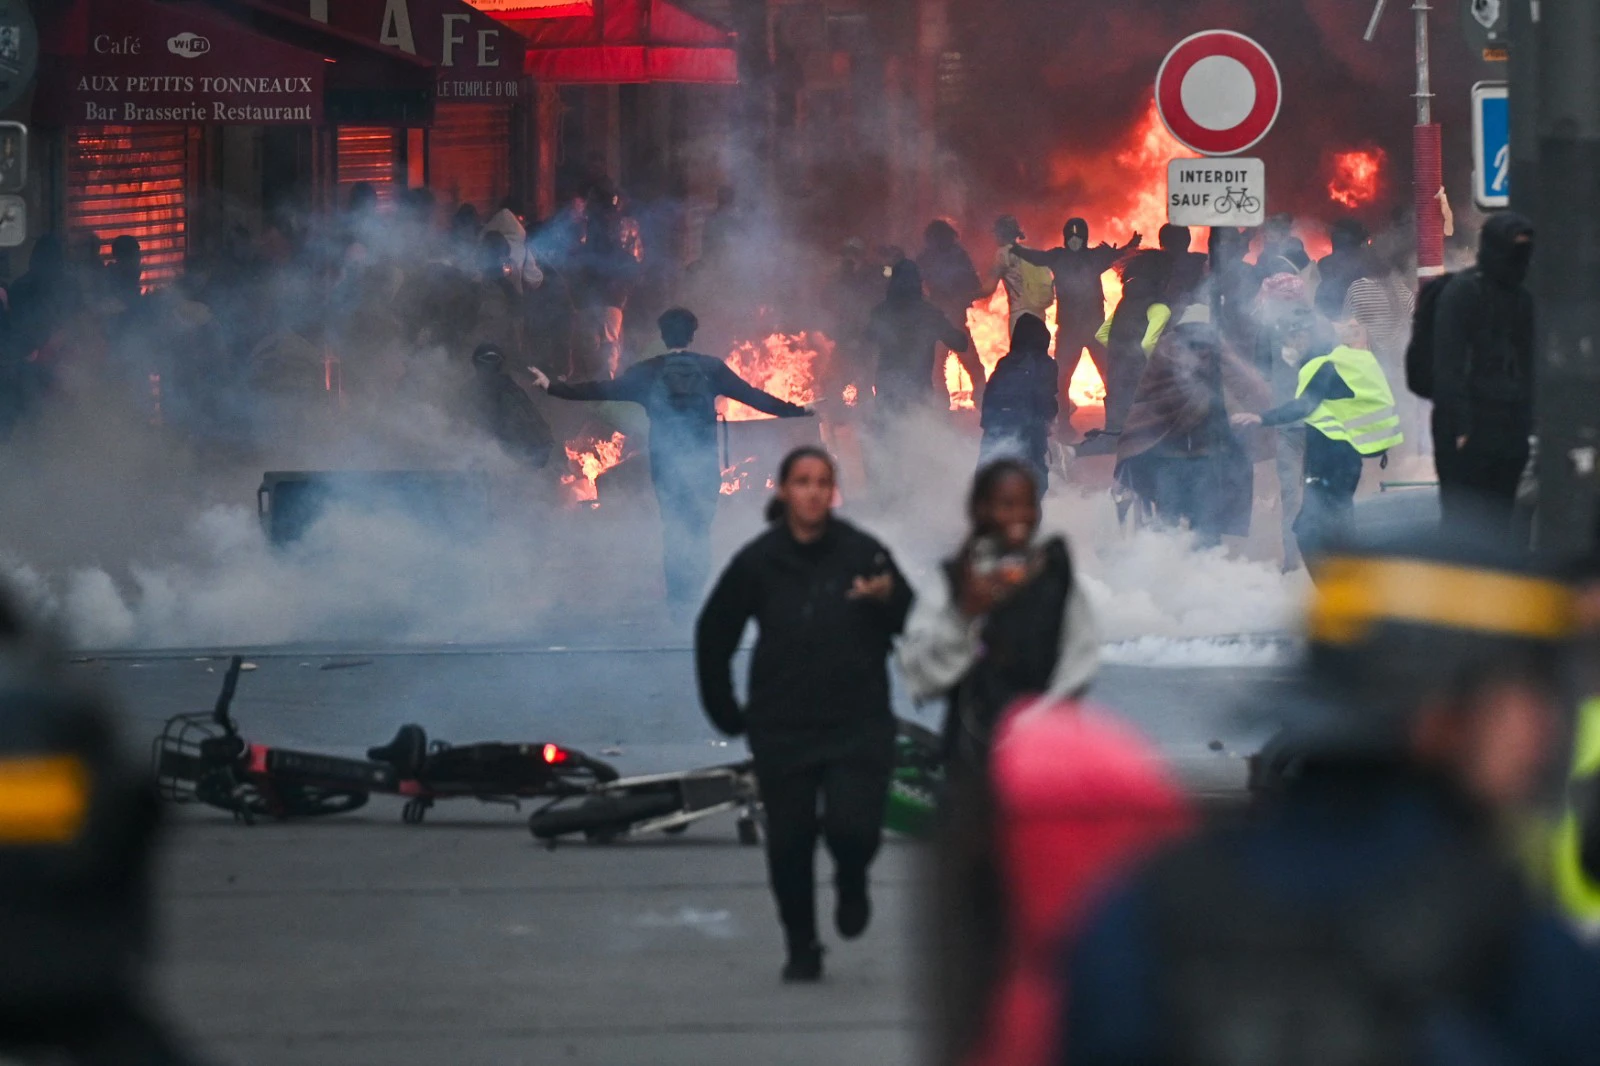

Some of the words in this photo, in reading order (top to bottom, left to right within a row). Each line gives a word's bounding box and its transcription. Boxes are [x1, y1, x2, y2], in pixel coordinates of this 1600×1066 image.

[94, 34, 141, 55] Café
[77, 76, 119, 92] AUX
[126, 76, 194, 92] PETITS
[200, 77, 312, 93] TONNEAUX
[437, 81, 450, 97] LE
[453, 81, 492, 97] TEMPLE
[86, 102, 117, 120] Bar
[124, 102, 207, 120] Brasserie
[213, 102, 312, 120] Restaurant
[1180, 170, 1248, 183] INTERDIT
[1171, 193, 1210, 206] SAUF
